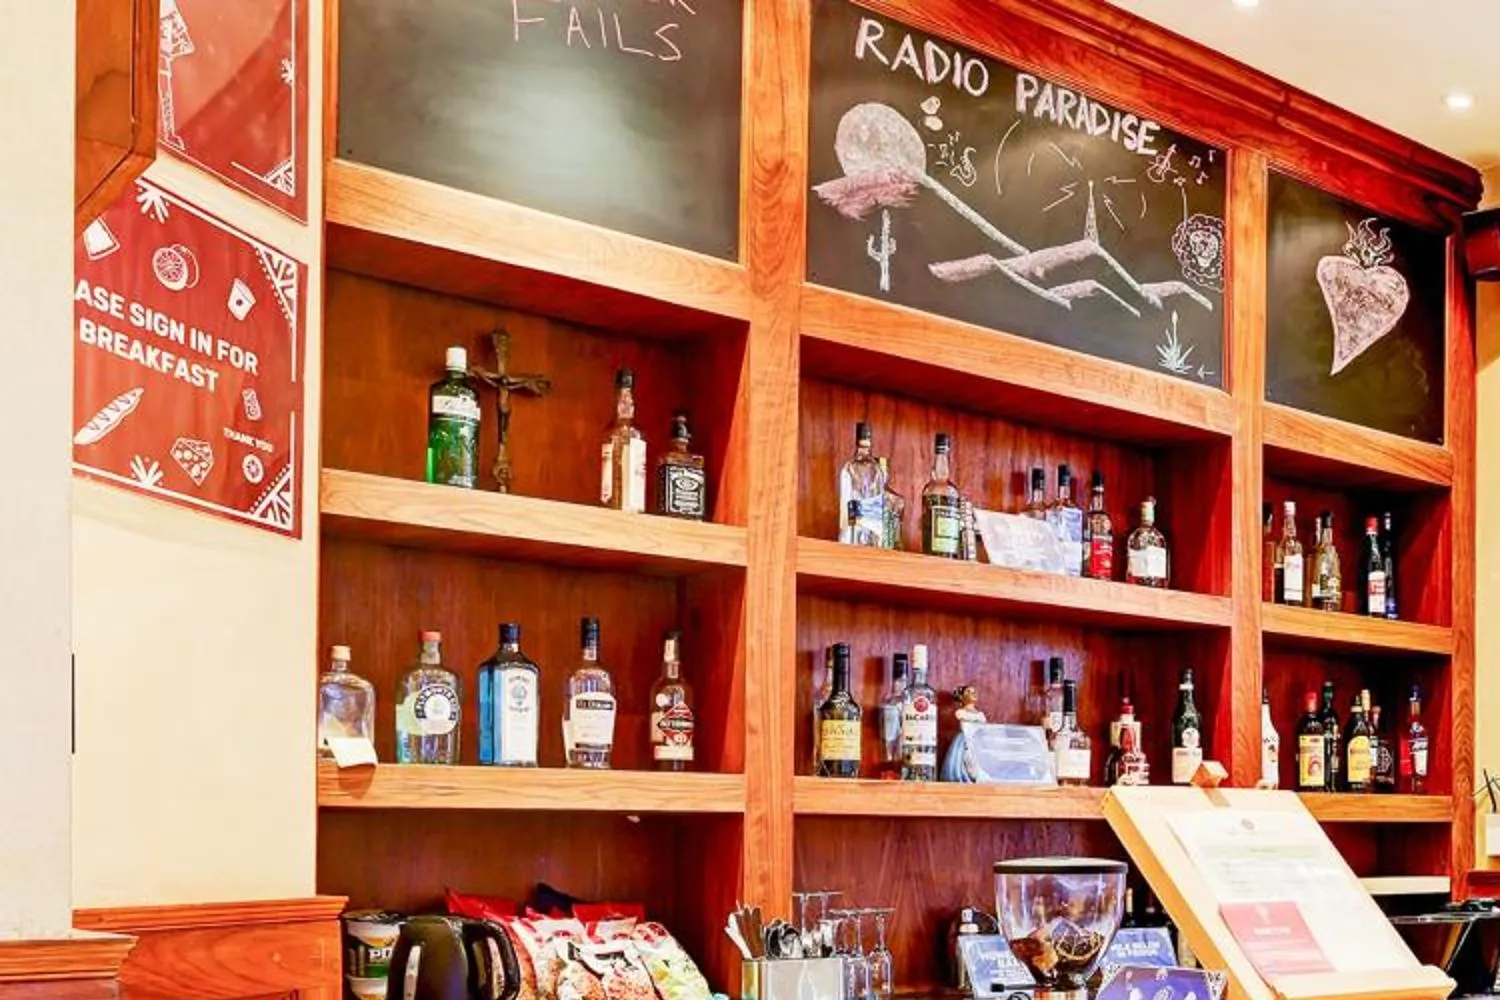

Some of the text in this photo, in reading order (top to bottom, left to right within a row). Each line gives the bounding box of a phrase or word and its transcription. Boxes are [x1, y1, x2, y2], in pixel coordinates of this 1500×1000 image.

[855, 17, 1162, 155] RADIO PARADISE
[79, 318, 219, 392] BREAKFAST
[129, 303, 185, 344] SIGN
[190, 328, 212, 356] IN
[217, 339, 259, 375] FOR
[368, 948, 392, 961] PO
